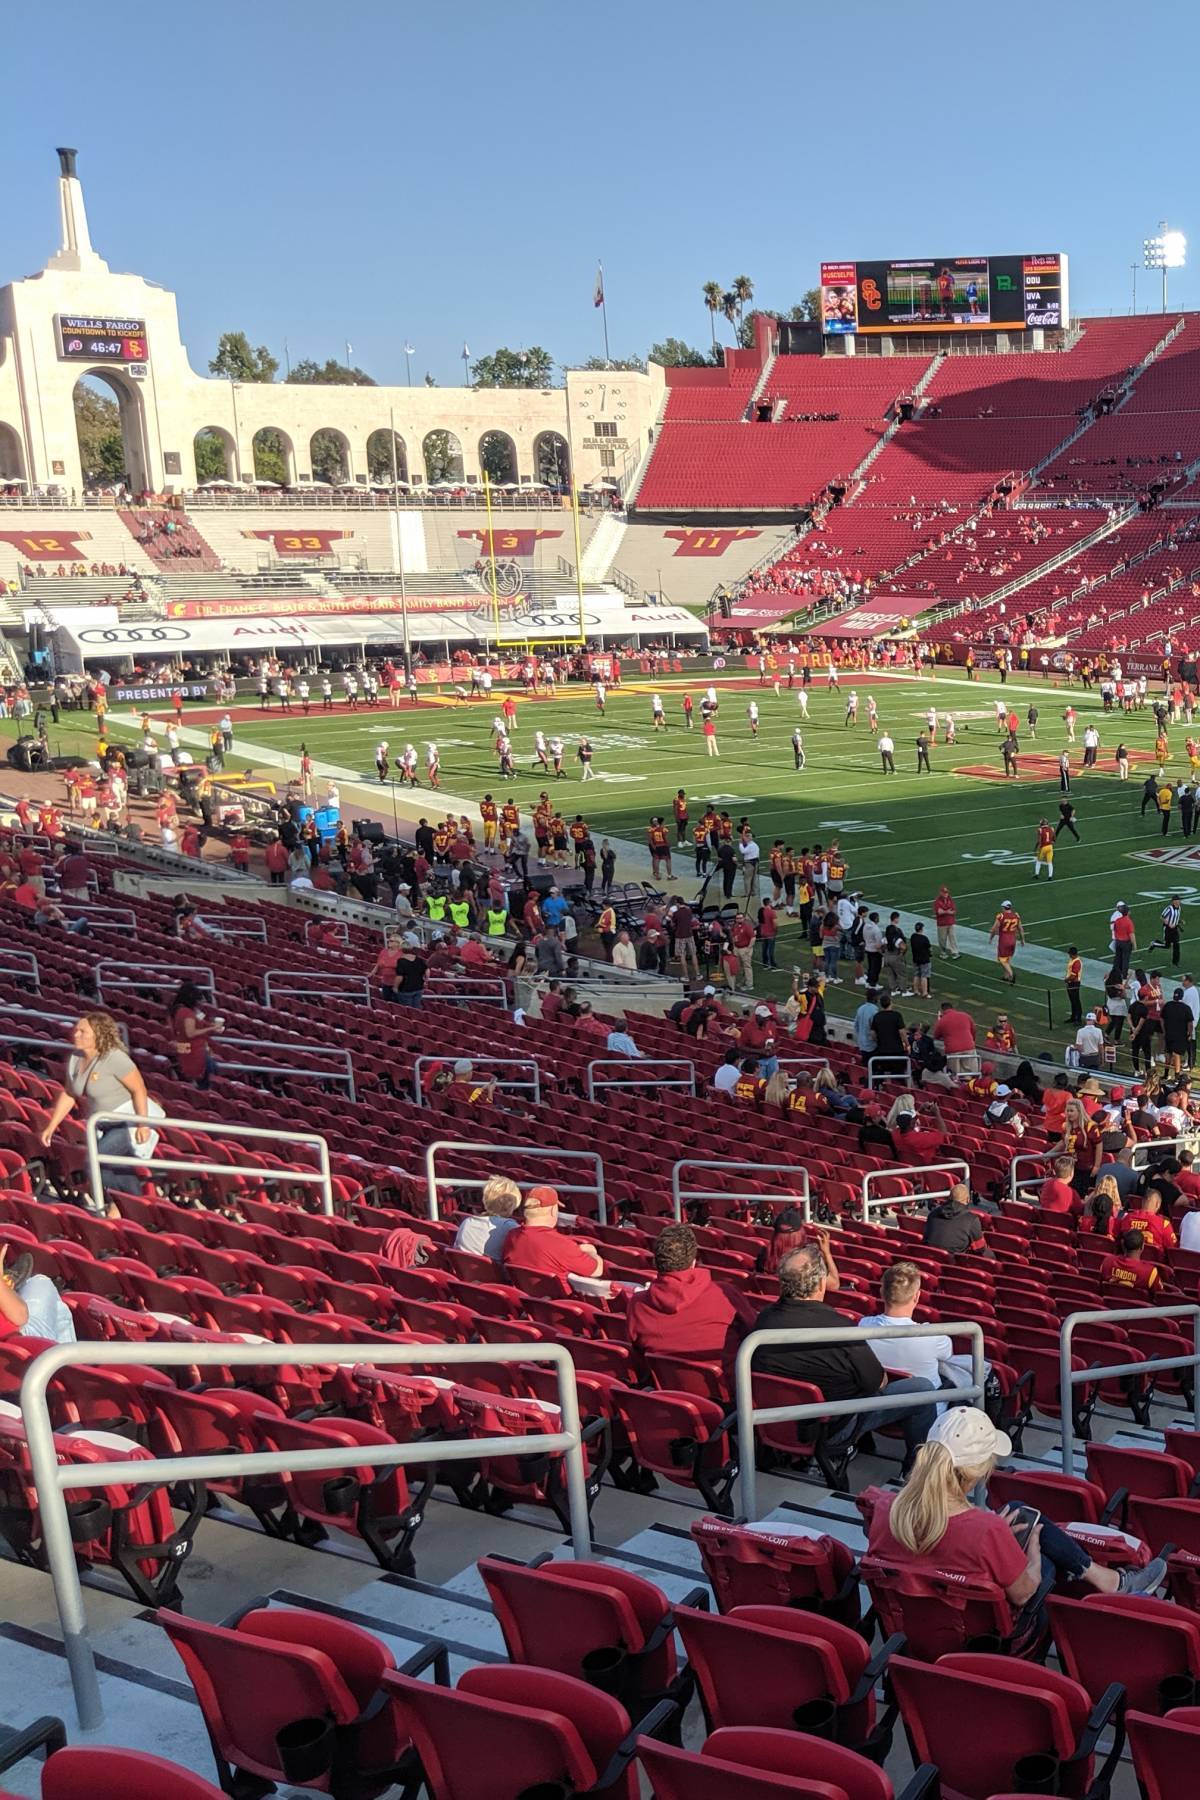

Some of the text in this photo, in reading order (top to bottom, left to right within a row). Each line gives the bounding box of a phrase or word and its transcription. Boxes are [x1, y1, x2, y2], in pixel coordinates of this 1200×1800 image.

[67, 320, 139, 330] WELLS FARGO
[63, 328, 106, 336] COUNTDOWN
[118, 330, 144, 338] KICKOFF
[91, 342, 121, 353] 46:47
[23, 538, 65, 552] 12
[285, 537, 322, 549] 33
[502, 536, 518, 549] 3
[692, 536, 720, 549] 11
[631, 613, 690, 621] Audi
[233, 624, 309, 636] Audi
[193, 686, 208, 696] BY
[1003, 919, 1017, 932] 72
[790, 1095, 807, 1113] 14
[1130, 1220, 1148, 1230] STEPP
[1111, 1267, 1137, 1281] LONDON
[590, 1484, 599, 1495] 25
[409, 1513, 421, 1526] 26
[176, 1540, 188, 1556] 27
